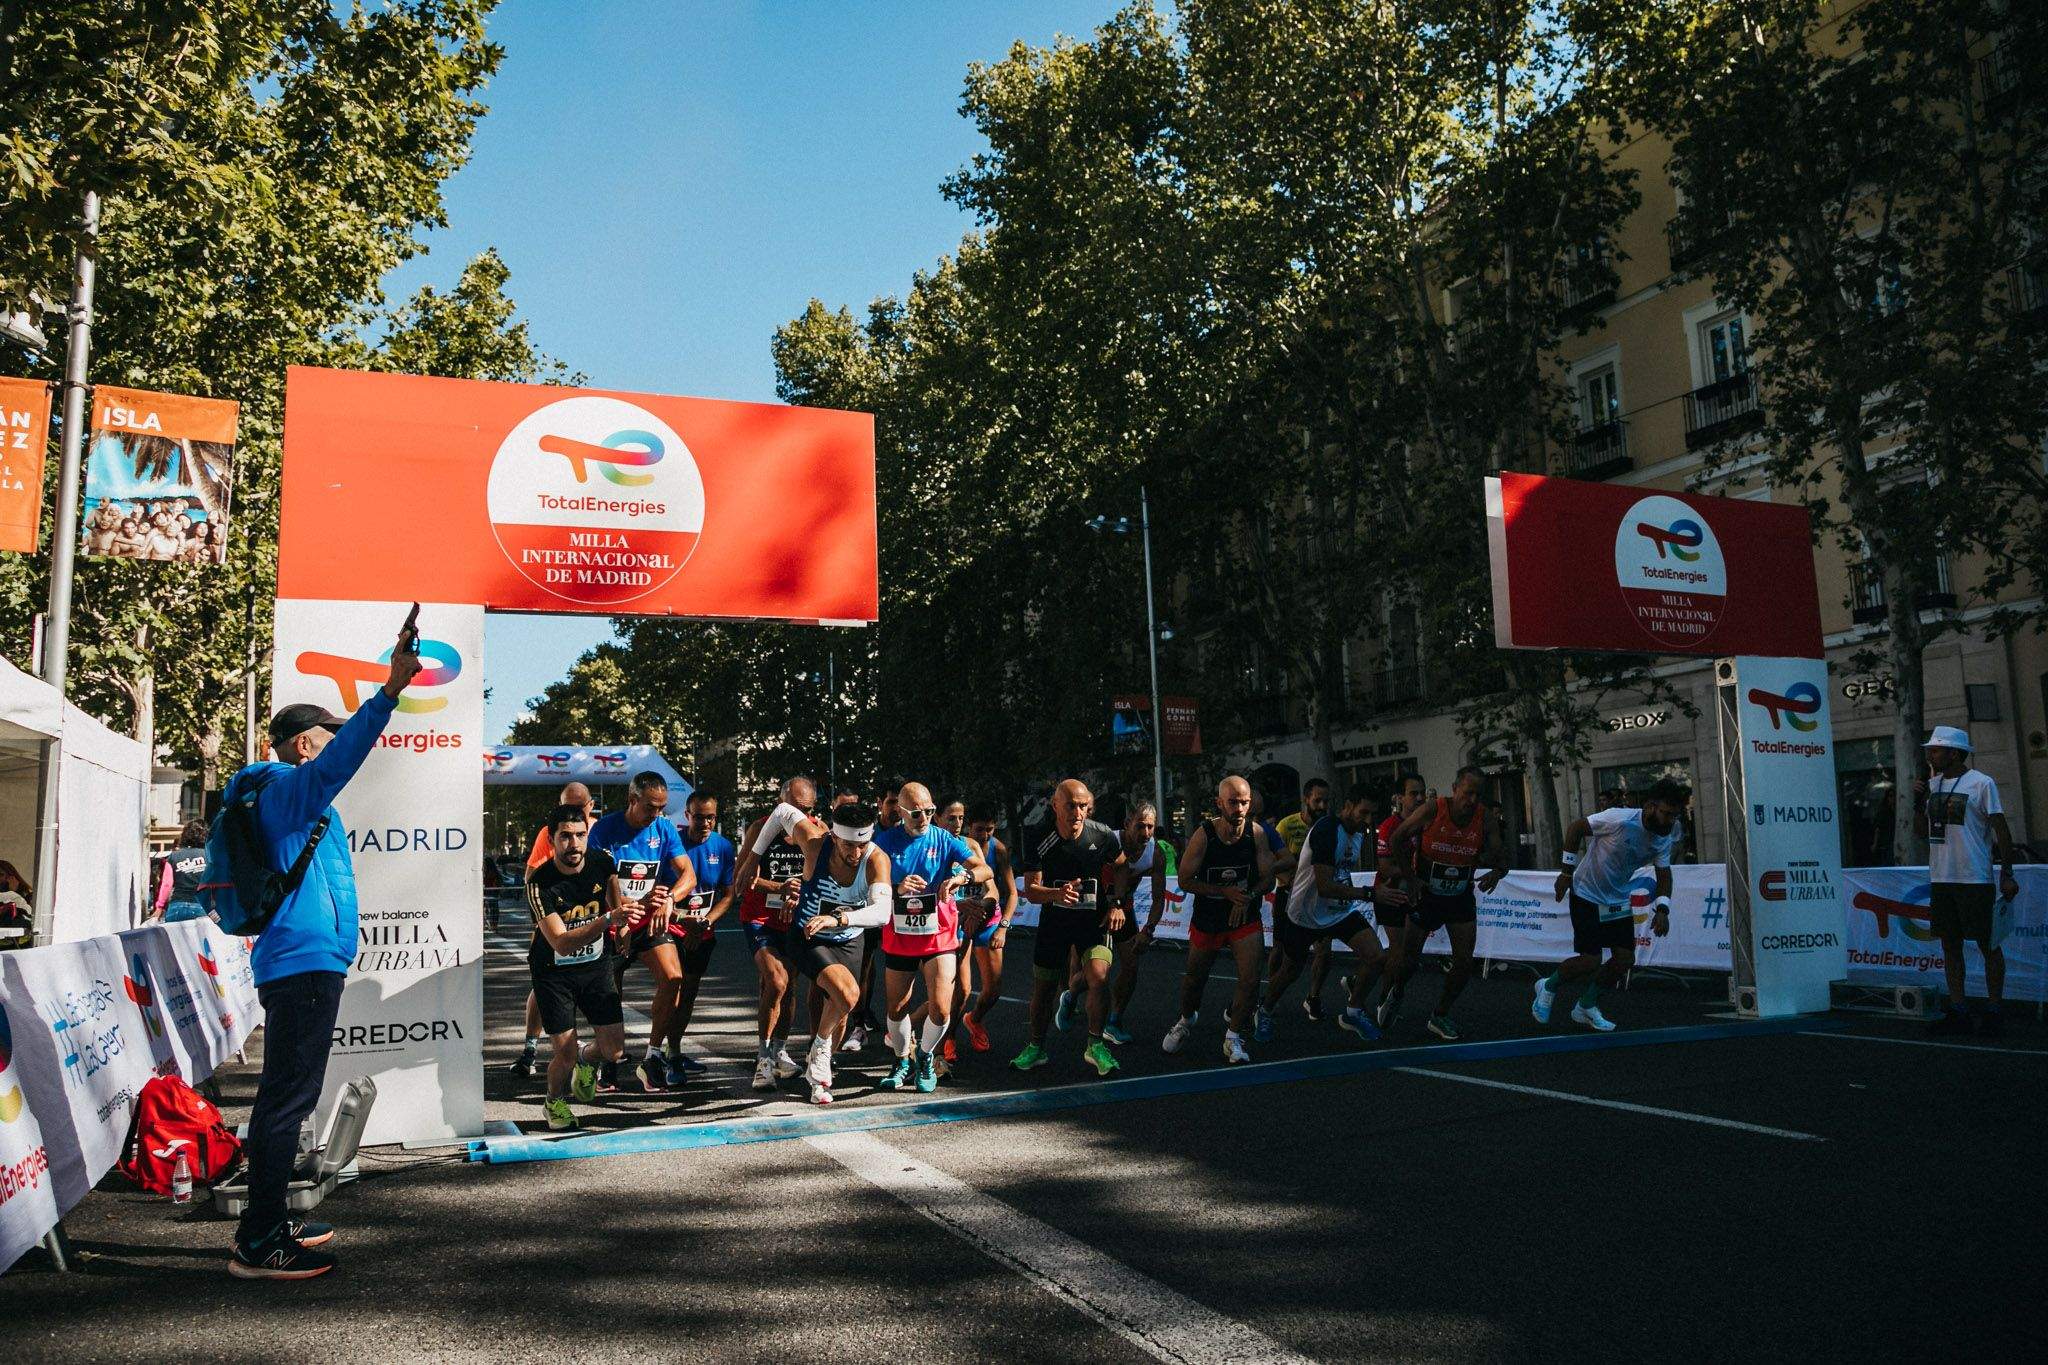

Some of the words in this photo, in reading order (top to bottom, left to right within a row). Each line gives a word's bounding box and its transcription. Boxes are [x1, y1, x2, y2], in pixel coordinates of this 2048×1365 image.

[103, 406, 163, 432] ISLA
[538, 494, 666, 517] TotalEnergies
[569, 532, 629, 549] MILLA
[545, 568, 573, 584] DE
[576, 569, 652, 586] MADRID
[1642, 565, 1708, 584] TotalEnergies
[1661, 594, 1693, 608] MILLA
[1651, 620, 1666, 633] DE
[1666, 621, 1706, 635] MADRID
[1609, 711, 1666, 732] GEOX
[1333, 745, 1376, 763] MICHAEL
[1752, 740, 1826, 758] TotalEnergies
[1774, 806, 1833, 823] MADRID
[627, 880, 646, 891] 410
[1789, 870, 1829, 884] MILLA
[1482, 896, 1503, 905] Somos
[1790, 885, 1836, 901] URBANA
[382, 909, 429, 920] balance
[905, 915, 927, 927] 420
[1514, 911, 1527, 919] que
[358, 924, 448, 947] MILLA
[357, 948, 463, 973] URBANA
[1847, 949, 1945, 972] TotalEnergie
